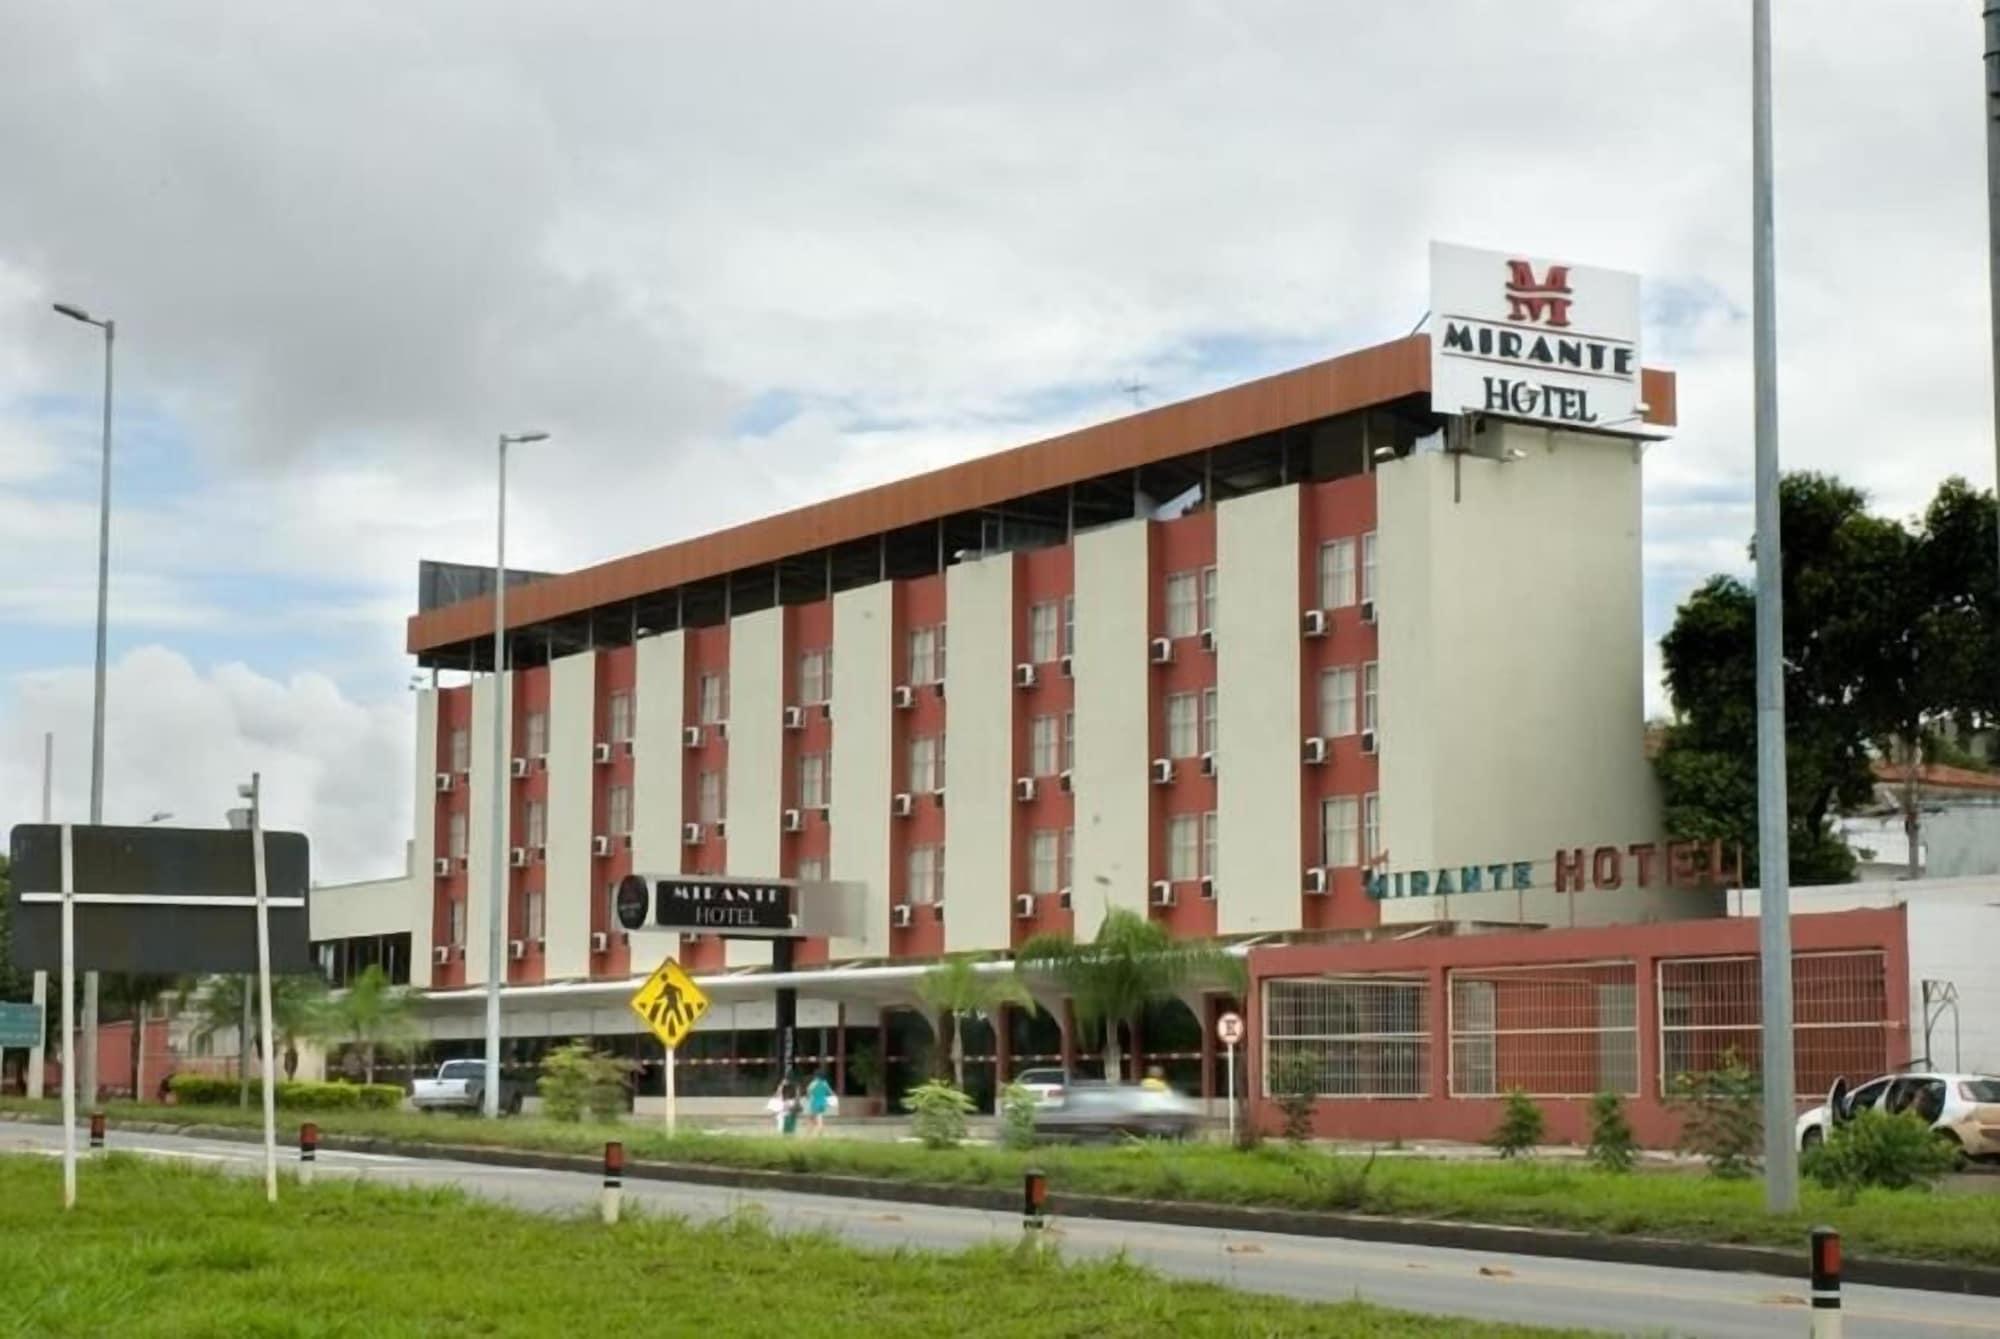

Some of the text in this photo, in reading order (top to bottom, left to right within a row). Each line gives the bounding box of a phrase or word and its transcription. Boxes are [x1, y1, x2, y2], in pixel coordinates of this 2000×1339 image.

[1442, 321, 1636, 376] MIRANTE
[1483, 375, 1599, 423] HOTEL
[1363, 838, 1738, 899] MIRANTE HOTEL
[674, 885, 777, 903] MIRANTE
[696, 905, 760, 925] HOTEL
